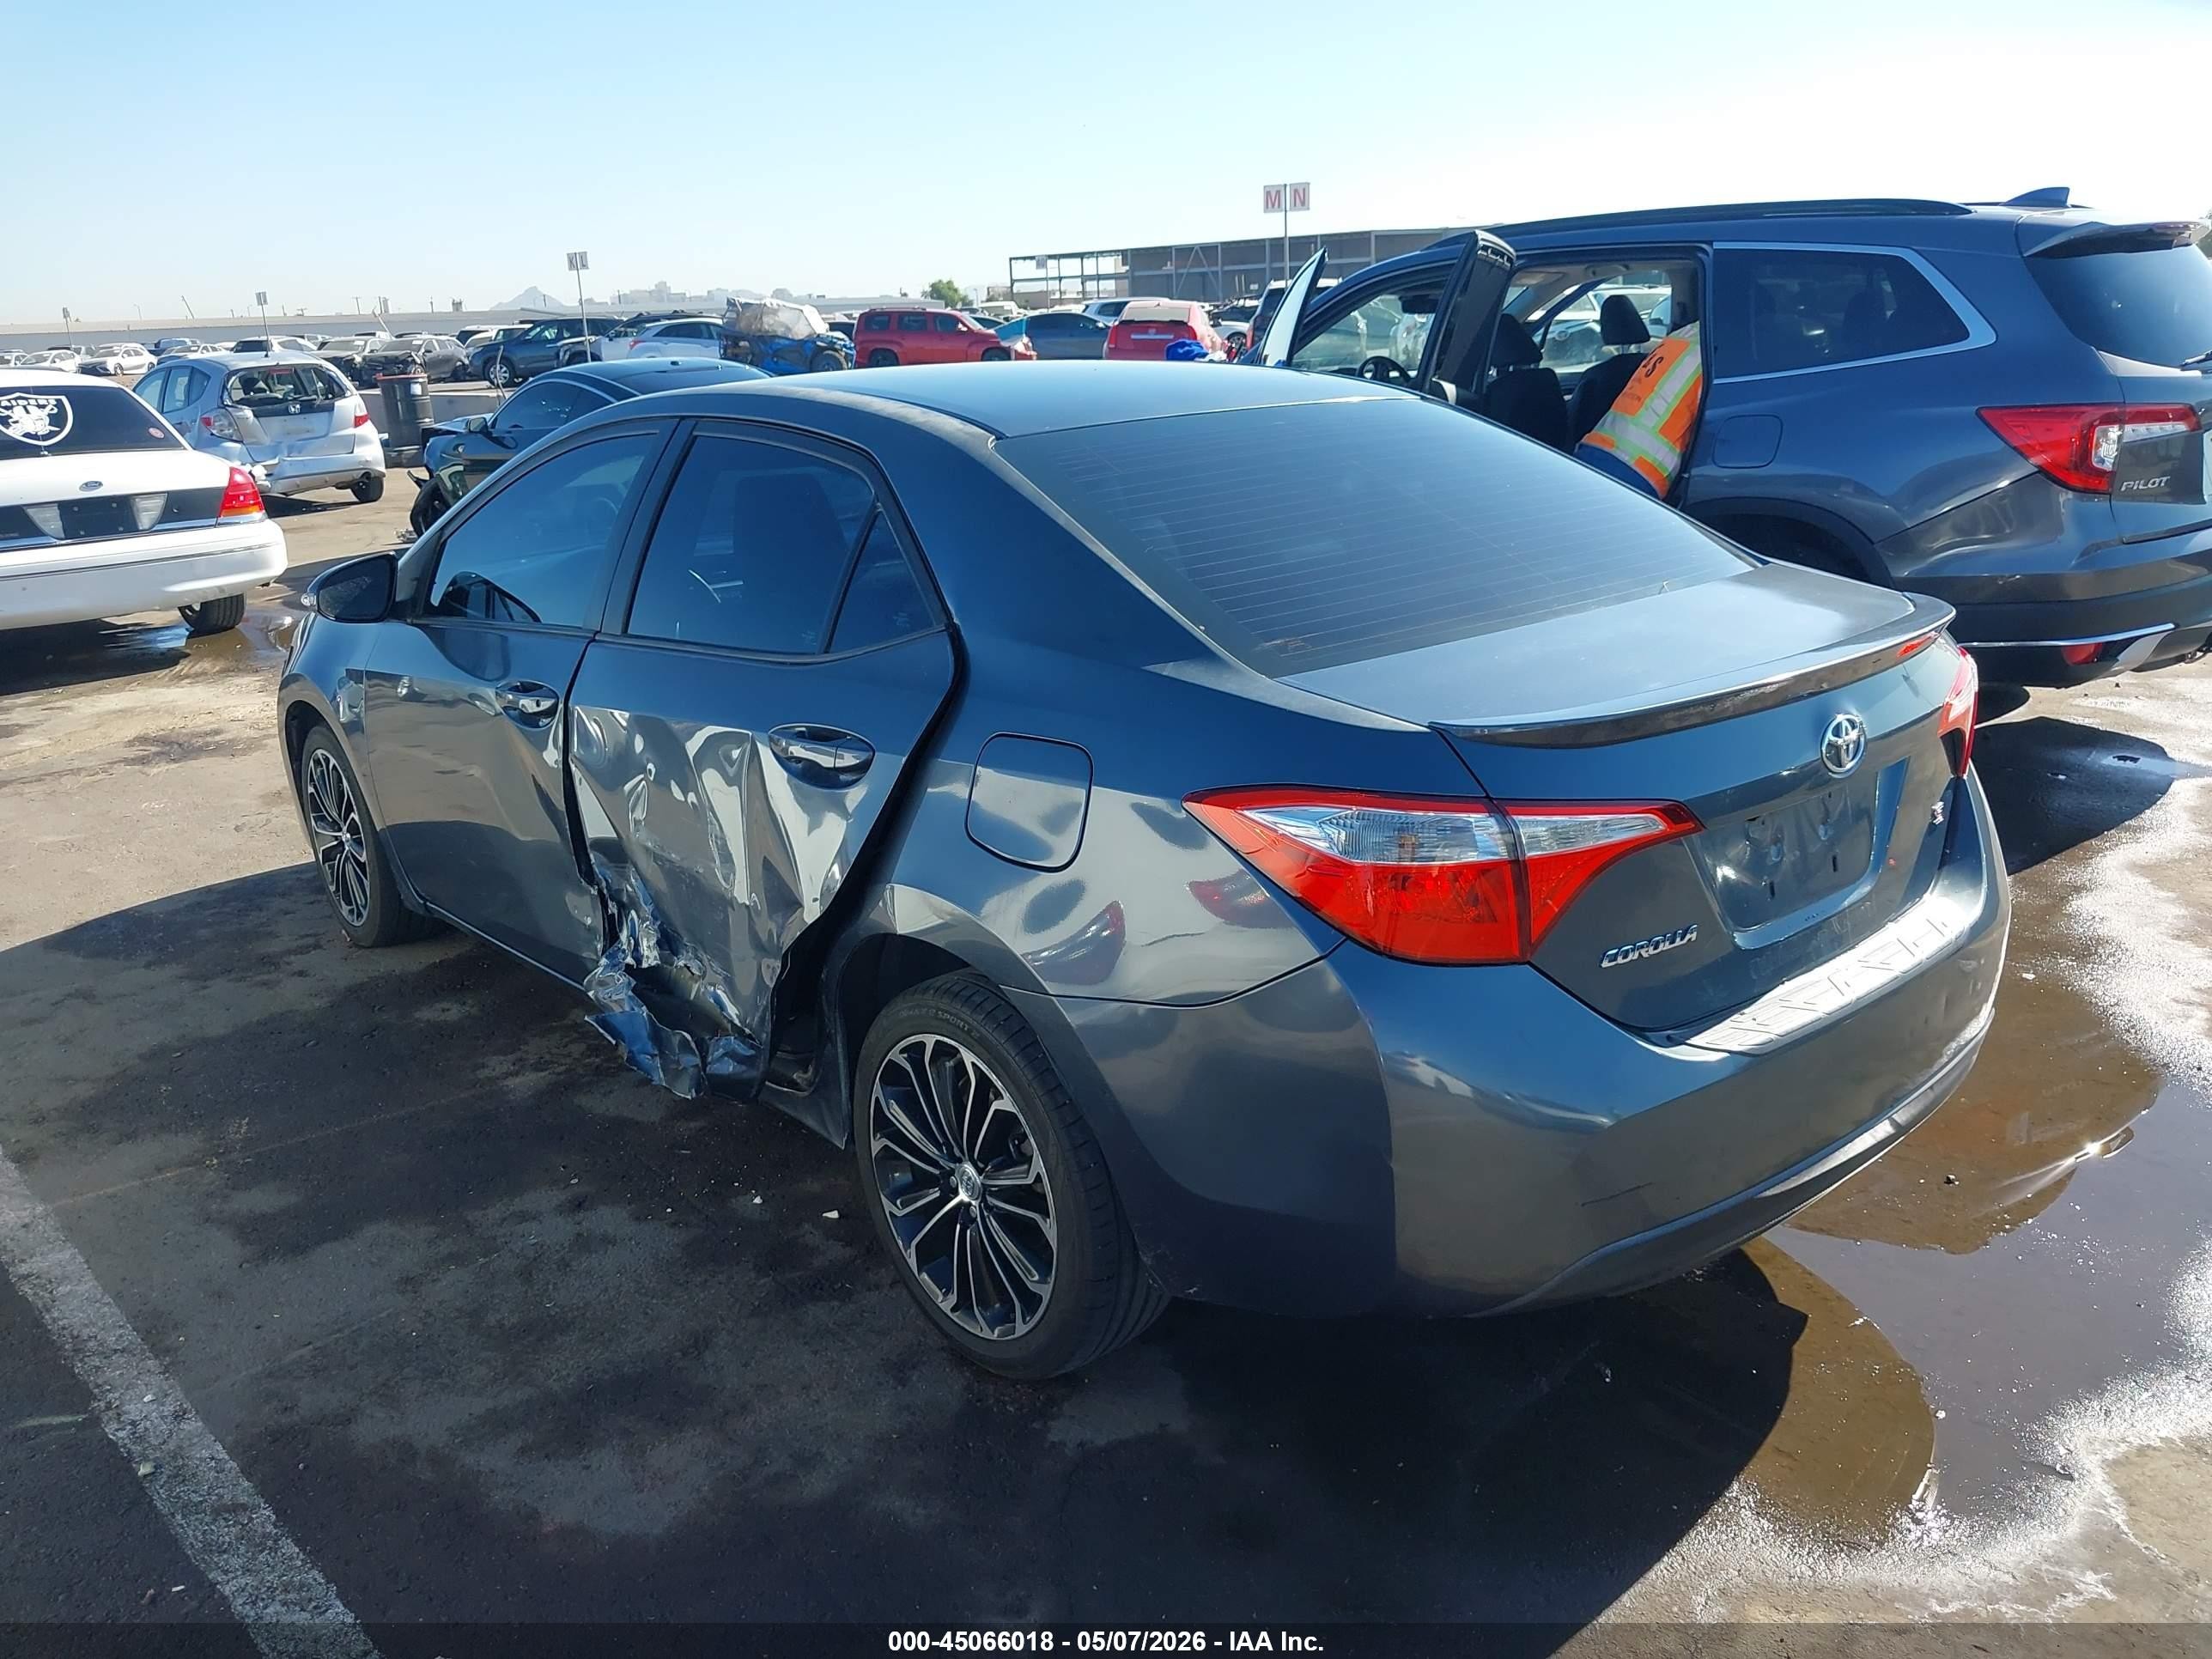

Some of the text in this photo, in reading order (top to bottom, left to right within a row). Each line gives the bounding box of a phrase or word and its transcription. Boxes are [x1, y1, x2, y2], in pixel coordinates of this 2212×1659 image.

[1266, 187, 1306, 210] M N
[0, 398, 58, 407] AIDERS
[2120, 476, 2171, 492] PILOT
[1600, 923, 1698, 969] COROLLA
